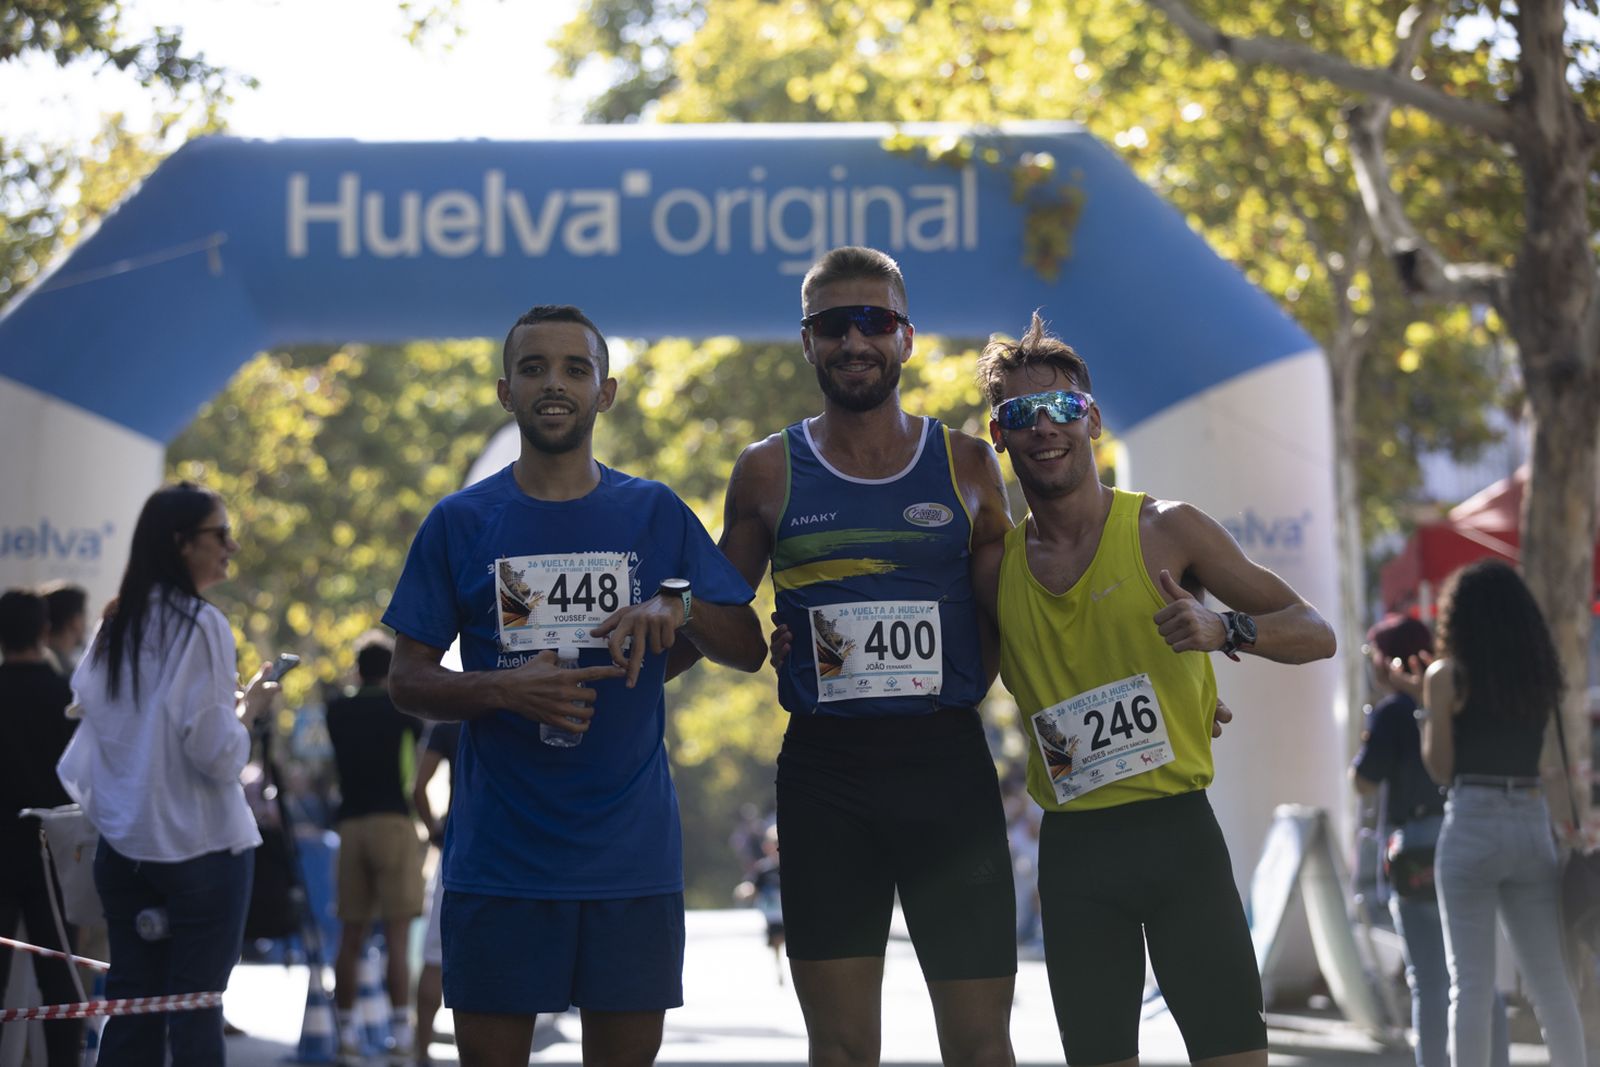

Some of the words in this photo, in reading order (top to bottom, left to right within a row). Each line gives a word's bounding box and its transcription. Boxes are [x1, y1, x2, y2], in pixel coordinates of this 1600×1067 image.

[287, 170, 618, 258] Huelva
[652, 166, 978, 276] original
[790, 512, 837, 527] ANAKY
[527, 560, 538, 569] 36
[541, 559, 575, 568] VUELTA
[578, 559, 586, 568] A
[587, 558, 621, 567] HUELVA
[547, 573, 619, 613] 448
[633, 579, 642, 604] 202
[554, 614, 586, 623] YOUSSEF
[839, 609, 849, 617] 36
[852, 607, 885, 616] VUELTA
[889, 606, 896, 614] A
[898, 606, 931, 614] HUELVA
[864, 620, 936, 661] 400
[497, 655, 537, 668] Huelv
[865, 662, 885, 671] JOÃO
[1056, 708, 1066, 717] 36
[1067, 694, 1098, 712] VUELTA
[1101, 690, 1108, 699] A
[1109, 680, 1144, 697] HUELVA
[1083, 695, 1158, 751] 246
[1081, 750, 1107, 765] MOISES
